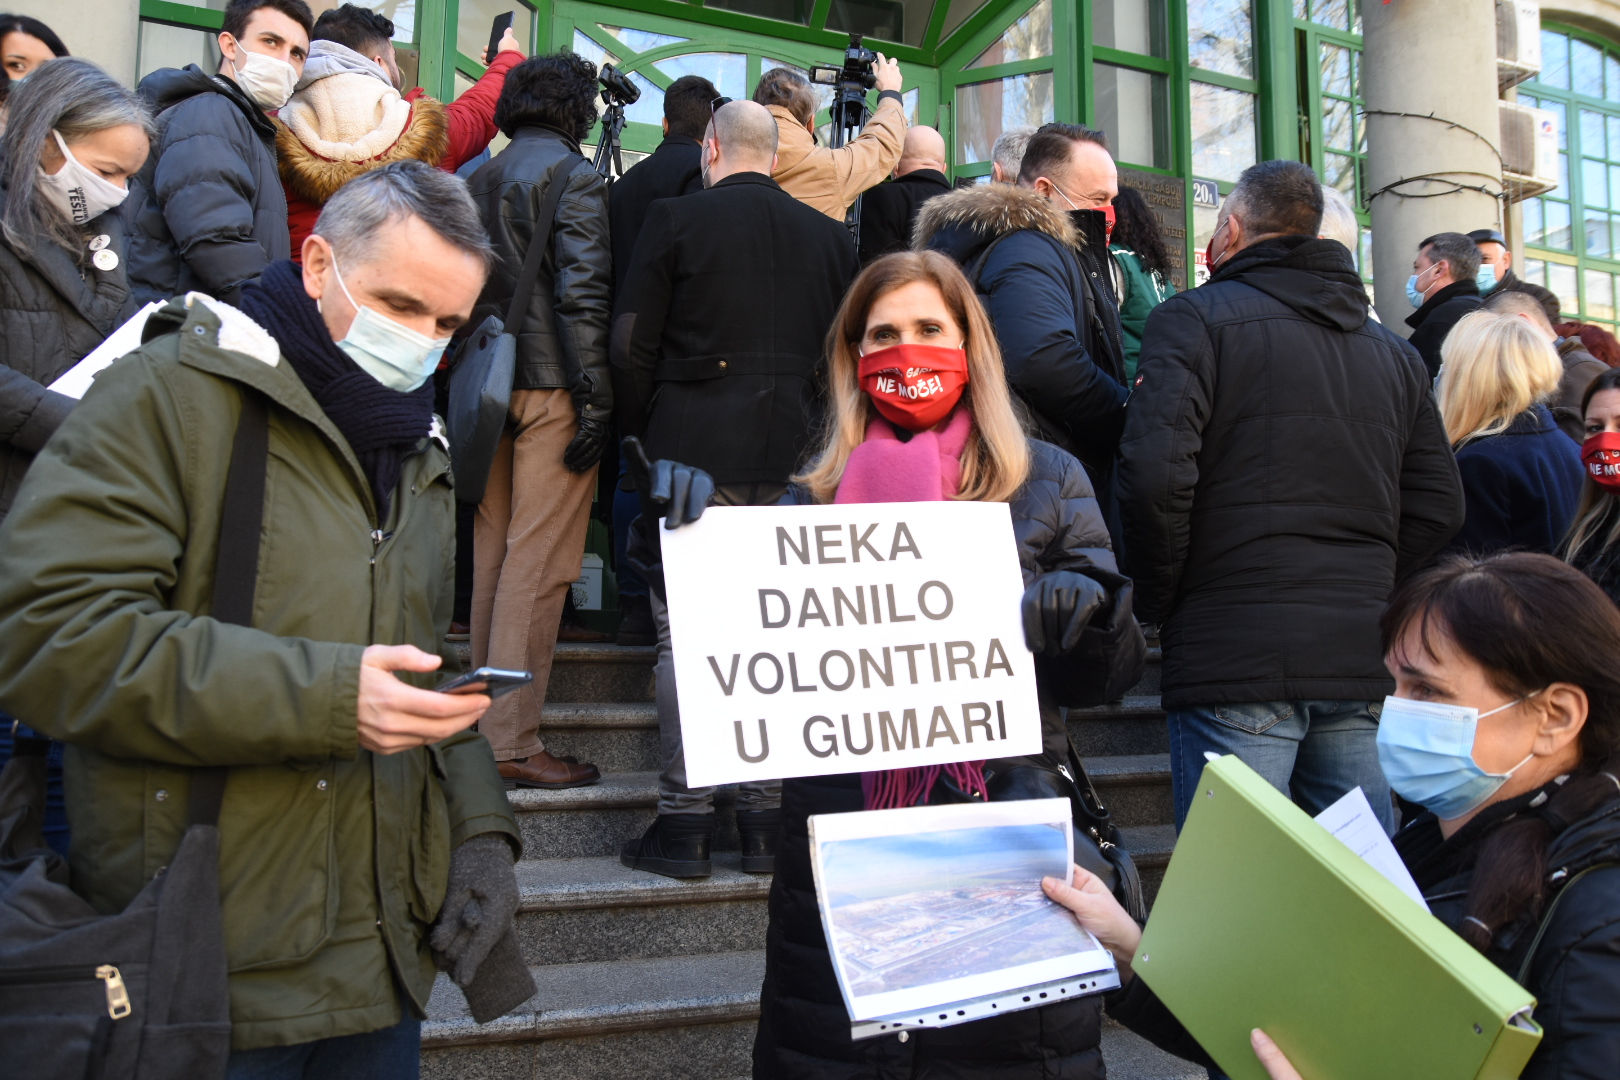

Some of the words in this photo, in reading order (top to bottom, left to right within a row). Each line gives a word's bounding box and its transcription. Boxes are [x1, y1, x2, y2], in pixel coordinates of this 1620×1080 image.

[68, 188, 83, 222] TESLU
[876, 375, 896, 393] NE
[1589, 462, 1602, 475] NE
[775, 521, 923, 566] NEKA
[757, 580, 954, 629] DANILO
[706, 637, 1015, 696] VOLONTIRA
[733, 718, 770, 764] U
[802, 700, 1008, 759] GUMARI
